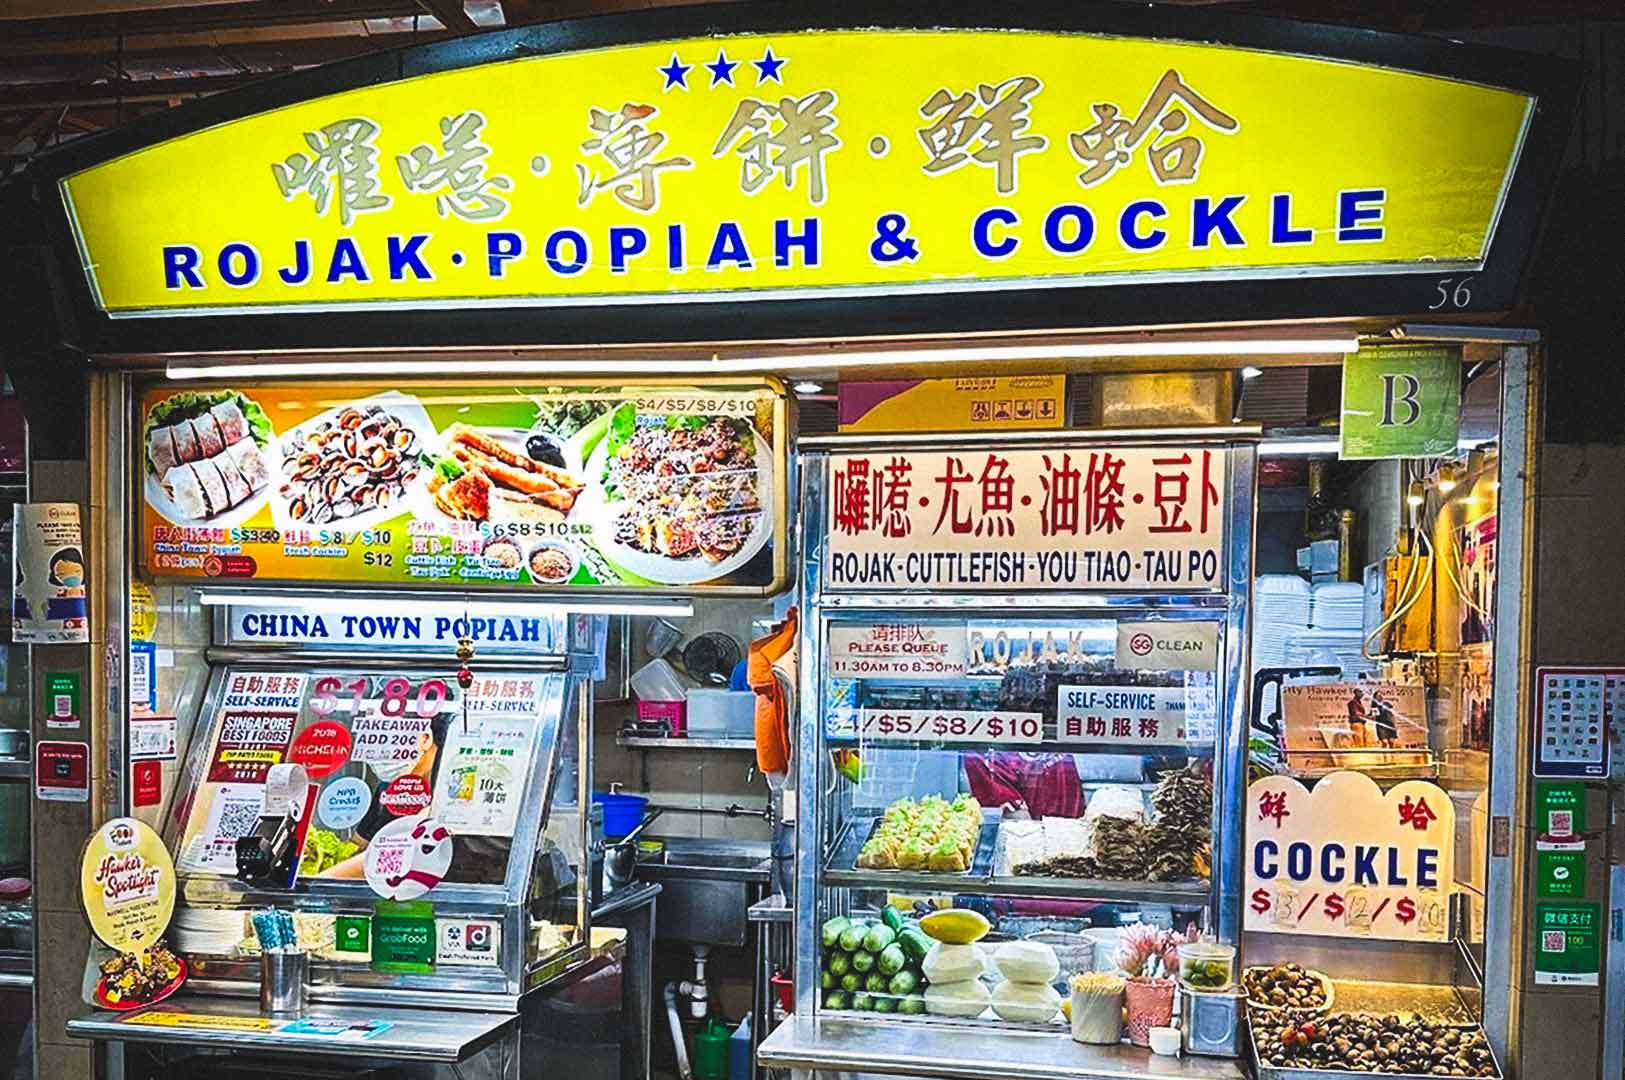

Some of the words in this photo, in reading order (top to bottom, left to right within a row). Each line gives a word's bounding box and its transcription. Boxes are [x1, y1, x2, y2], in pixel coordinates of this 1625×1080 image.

[165, 233, 430, 289] ROJAK
[489, 217, 820, 277] POPIAH
[872, 214, 919, 261] &
[974, 189, 1385, 257] COCKLE
[1429, 277, 1472, 310] 56
[1376, 373, 1421, 428] B
[363, 551, 393, 567] $12
[832, 551, 896, 583] ROJAK
[906, 551, 1025, 583] CUTTLEFISH
[1036, 551, 1085, 582] YOU
[1086, 550, 1131, 582] TIAO
[1143, 550, 1181, 581] TAU
[1188, 550, 1217, 581] PO
[241, 613, 329, 638] CHINA
[341, 616, 422, 640] TOWN
[434, 617, 541, 642] POPIAH
[848, 642, 899, 654] PLEASE
[902, 642, 949, 654] QUEUE
[970, 630, 1084, 667] ROJAK
[1156, 639, 1204, 651] CLEAN
[834, 661, 889, 673] 11.30AM
[893, 662, 908, 673] TO
[911, 661, 964, 673] 8.30PM
[224, 695, 300, 708] SELF-SERVICE
[1067, 691, 1156, 711] SELF-SERVICE
[224, 716, 294, 731] SINGAPORE
[355, 719, 430, 732] TAKEAWAY
[221, 730, 250, 742] BEST
[252, 731, 289, 743] FOODS
[357, 734, 388, 745] ADD
[1258, 790, 1290, 829] 鮮
[1398, 795, 1437, 830] 蛤
[96, 855, 142, 882] Hawker
[1253, 840, 1439, 888] COCKLE
[105, 869, 160, 898] Spotlight
